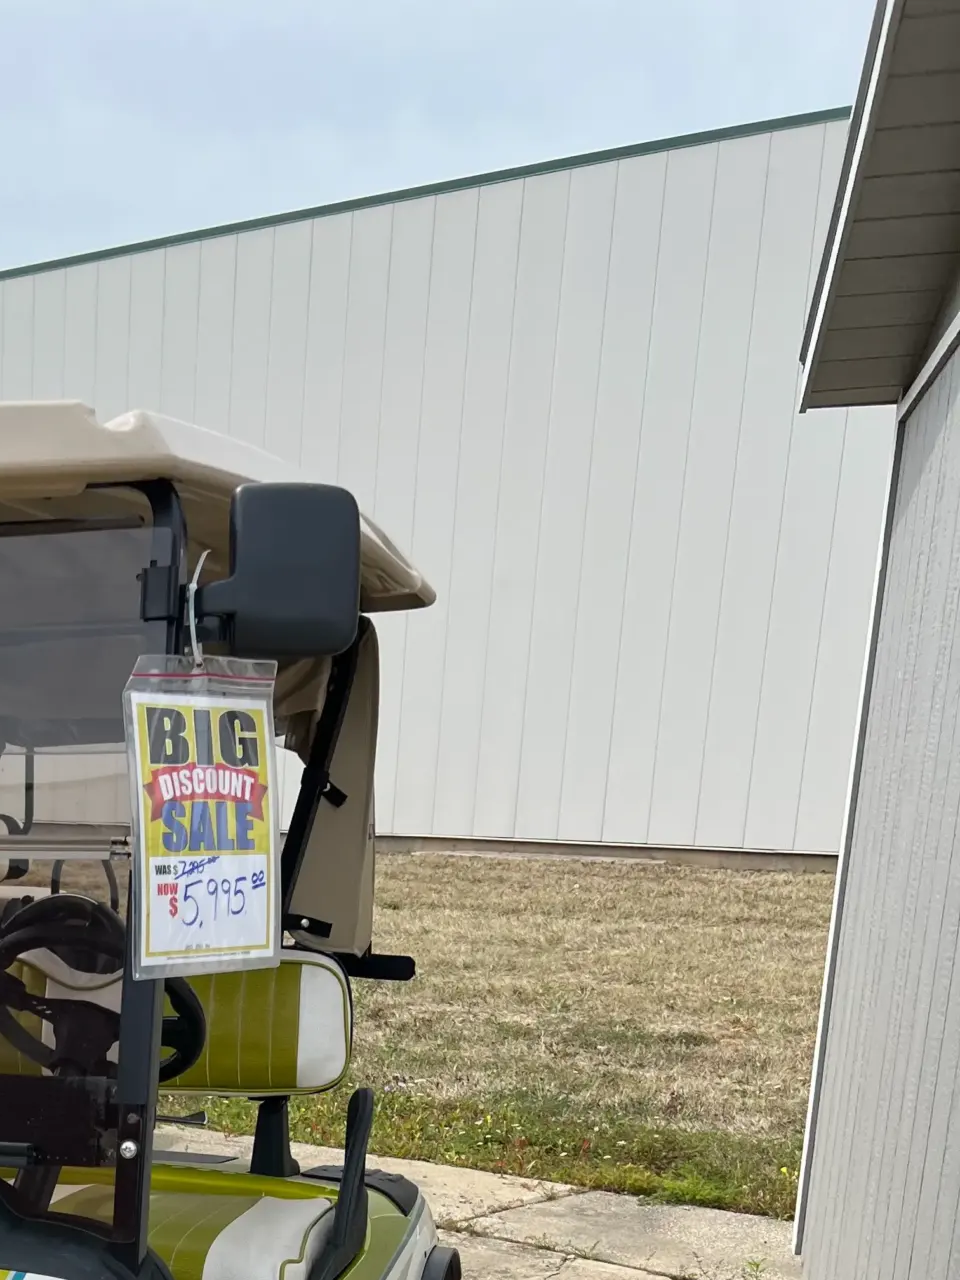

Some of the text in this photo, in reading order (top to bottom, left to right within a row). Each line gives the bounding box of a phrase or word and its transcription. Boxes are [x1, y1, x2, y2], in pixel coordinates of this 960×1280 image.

[146, 707, 259, 768] BIG
[158, 767, 255, 801] DISCOUNT
[161, 800, 255, 852] SALE
[155, 864, 172, 876] WAS
[157, 883, 179, 896] NOW
[169, 895, 179, 918] $
